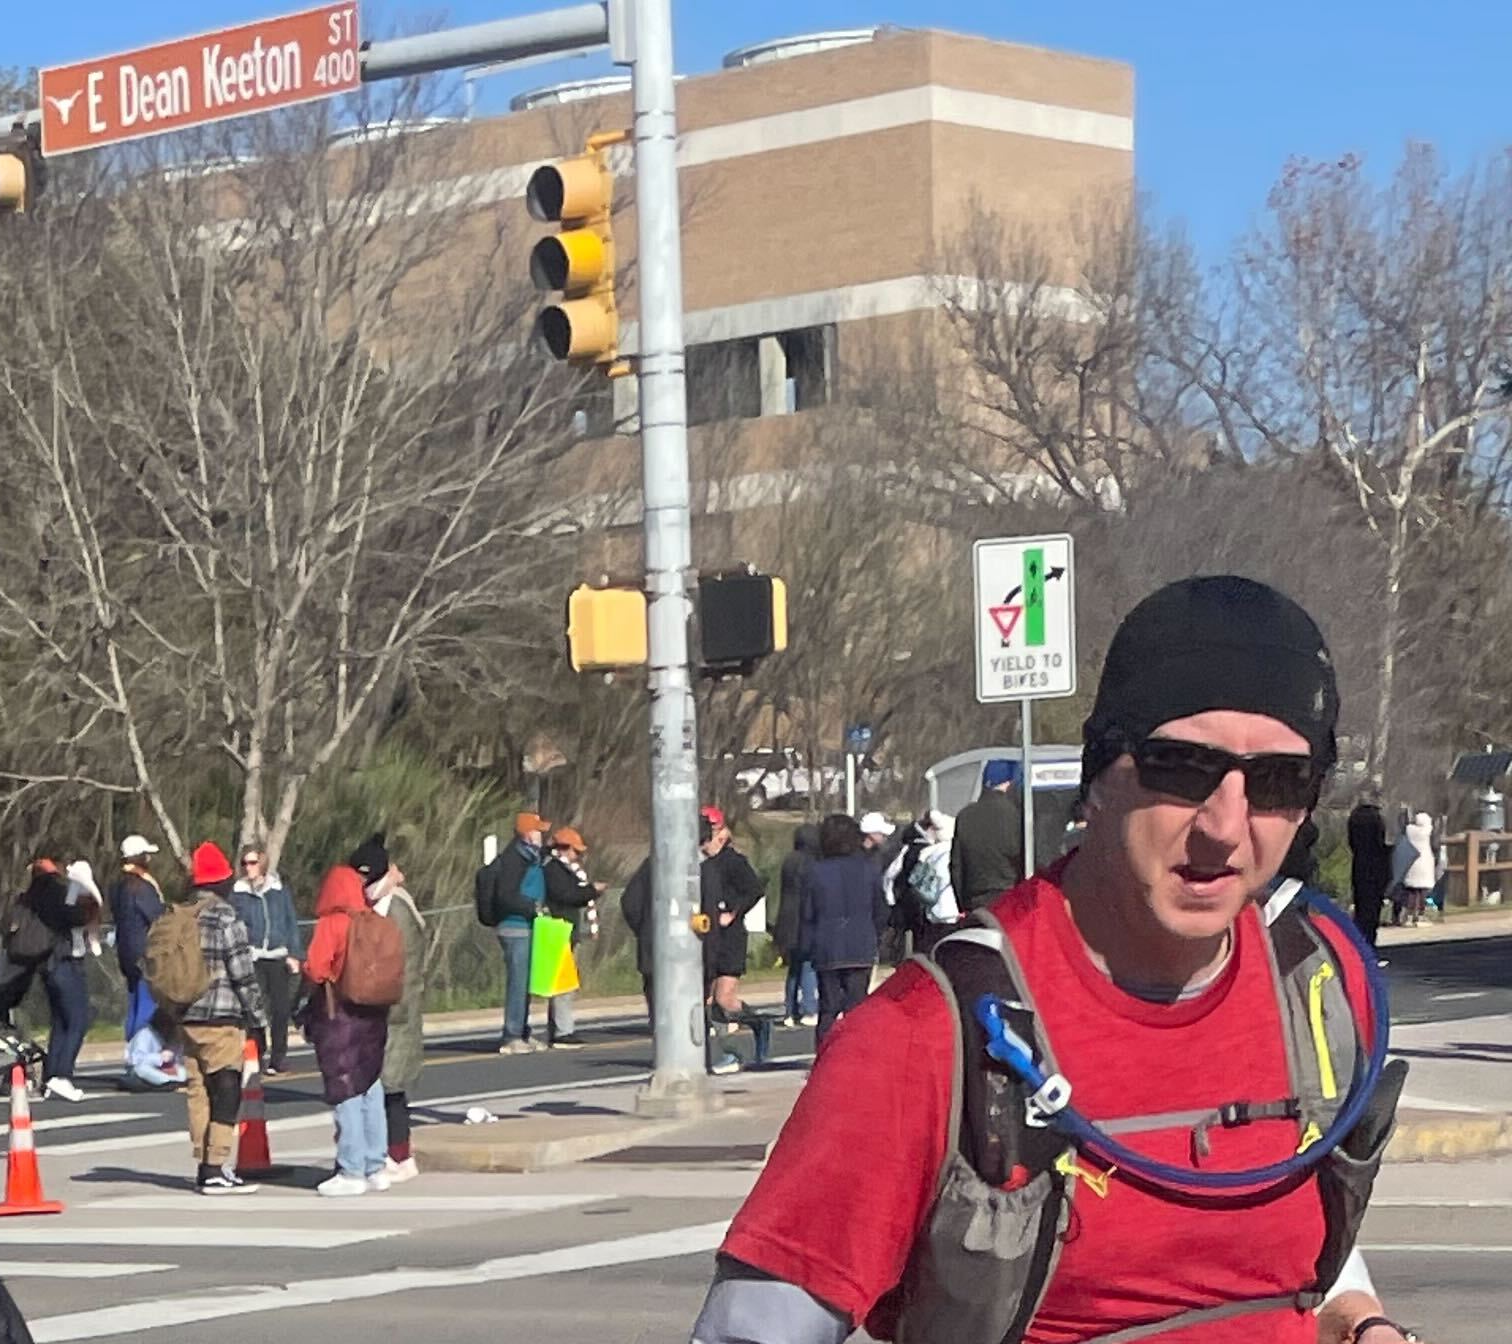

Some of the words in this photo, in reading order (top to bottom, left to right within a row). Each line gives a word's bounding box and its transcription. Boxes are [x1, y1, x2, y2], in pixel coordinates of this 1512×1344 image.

[328, 9, 353, 45] ST
[88, 71, 107, 133] E
[120, 64, 190, 127] Dean
[202, 36, 302, 109] Keeton
[313, 48, 355, 88] 400
[990, 655, 1035, 672] YIELD
[1042, 653, 1062, 669] TO
[1003, 672, 1049, 689] BIKES
